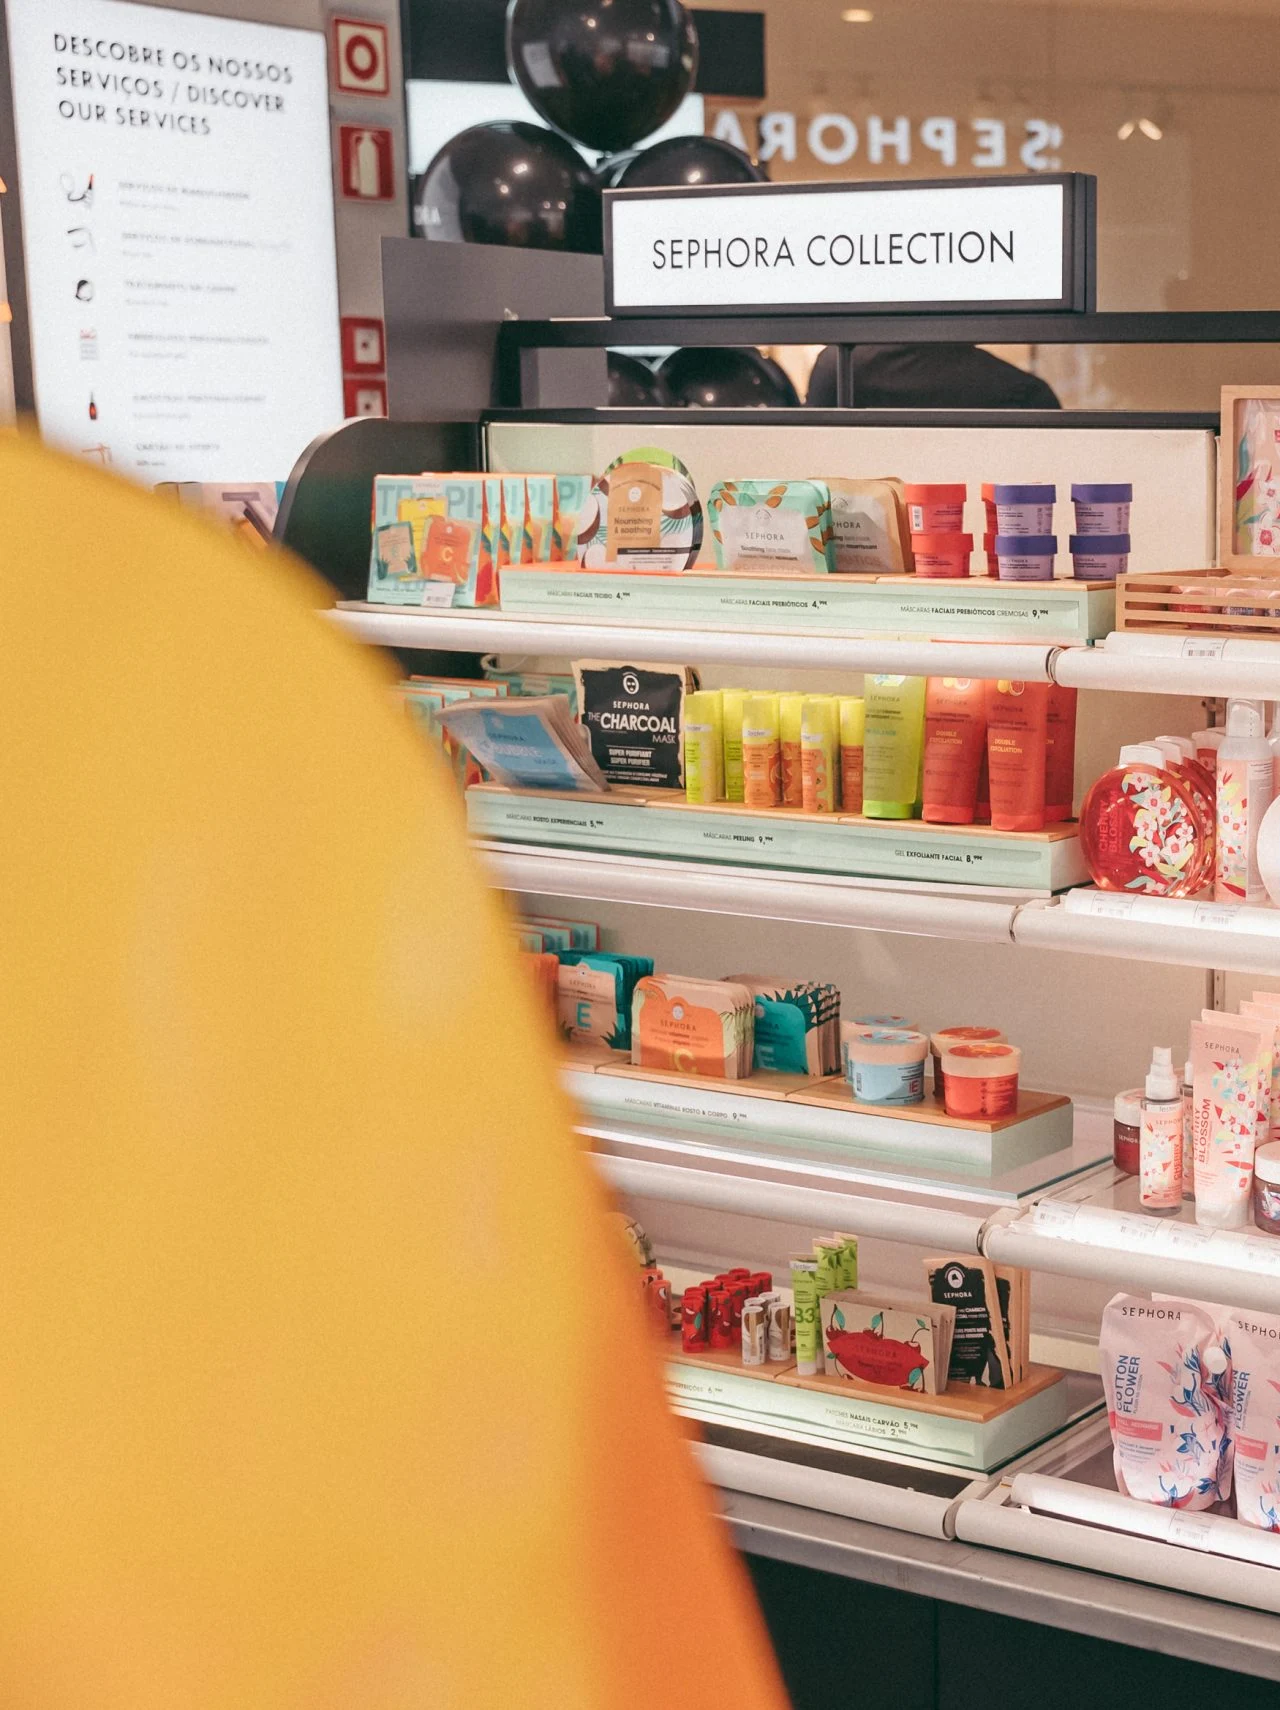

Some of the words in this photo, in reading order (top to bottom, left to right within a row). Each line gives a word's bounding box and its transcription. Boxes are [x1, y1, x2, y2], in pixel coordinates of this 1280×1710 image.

[53, 33, 164, 67] DESCOBRE
[173, 51, 200, 72] OS
[209, 56, 293, 84] NOSSOS
[56, 67, 163, 98] SERVIÇOS
[172, 81, 180, 104] /
[187, 85, 285, 112] DISCOVER
[58, 99, 106, 121] OUR
[116, 107, 211, 136] SERVICES
[651, 236, 795, 270] SEPHORA
[806, 230, 1015, 267] COLLECTION
[614, 518, 654, 526] Nourishing
[620, 527, 652, 535] soothing
[745, 532, 785, 541] SEPHORA
[772, 600, 808, 608] PREBIÓTICOS
[901, 605, 931, 613] MÁSCARAS
[956, 608, 995, 616] PREBIÓTICOS
[613, 701, 650, 710] SEPHORA
[588, 712, 600, 721] THE
[600, 713, 676, 733] CHARCOAL
[652, 735, 676, 744] MASK
[995, 738, 1015, 746] DOUBLE
[1109, 791, 1118, 852] BLOSSOM
[733, 834, 755, 843] PEELING
[906, 851, 940, 860] EXFOLIANTE
[942, 854, 963, 862] FACIAL
[576, 1002, 592, 1028] E
[659, 1019, 697, 1032] SEPHORA
[1205, 1041, 1240, 1054] SEPHORA
[674, 1047, 697, 1074] C
[1199, 1098, 1212, 1163] BLOSSOM
[1118, 1134, 1138, 1144] SEPHOR
[1122, 1306, 1181, 1320] SEPHORA
[1123, 1356, 1141, 1413] FLOWER
[1236, 1371, 1250, 1429] FLOWER
[849, 1413, 871, 1423] NASAIS
[872, 1417, 900, 1428] CARVÃO
